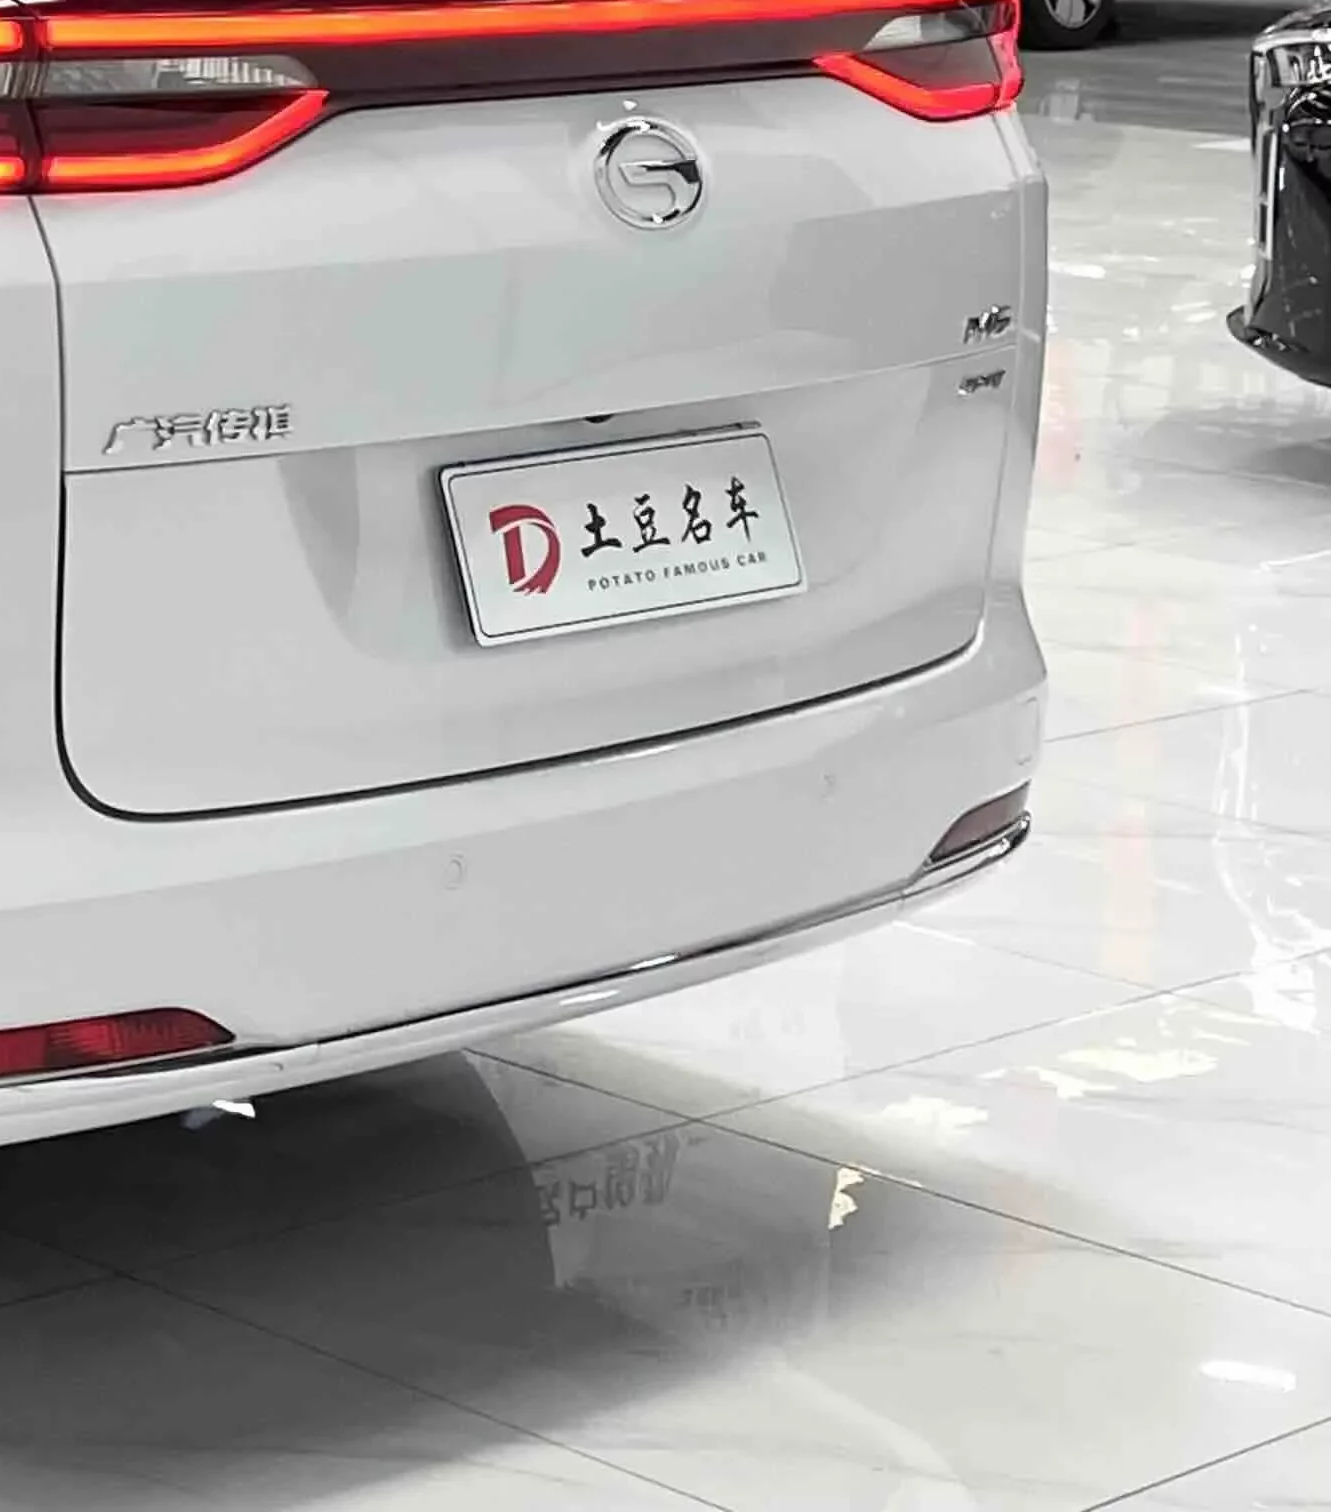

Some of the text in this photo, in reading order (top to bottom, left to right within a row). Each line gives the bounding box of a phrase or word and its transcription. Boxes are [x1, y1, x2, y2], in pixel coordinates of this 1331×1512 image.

[101, 402, 291, 455] 广汽传祺
[581, 476, 759, 558] 土豆名车
[588, 550, 767, 592] POTATO FAMOUS CAR
